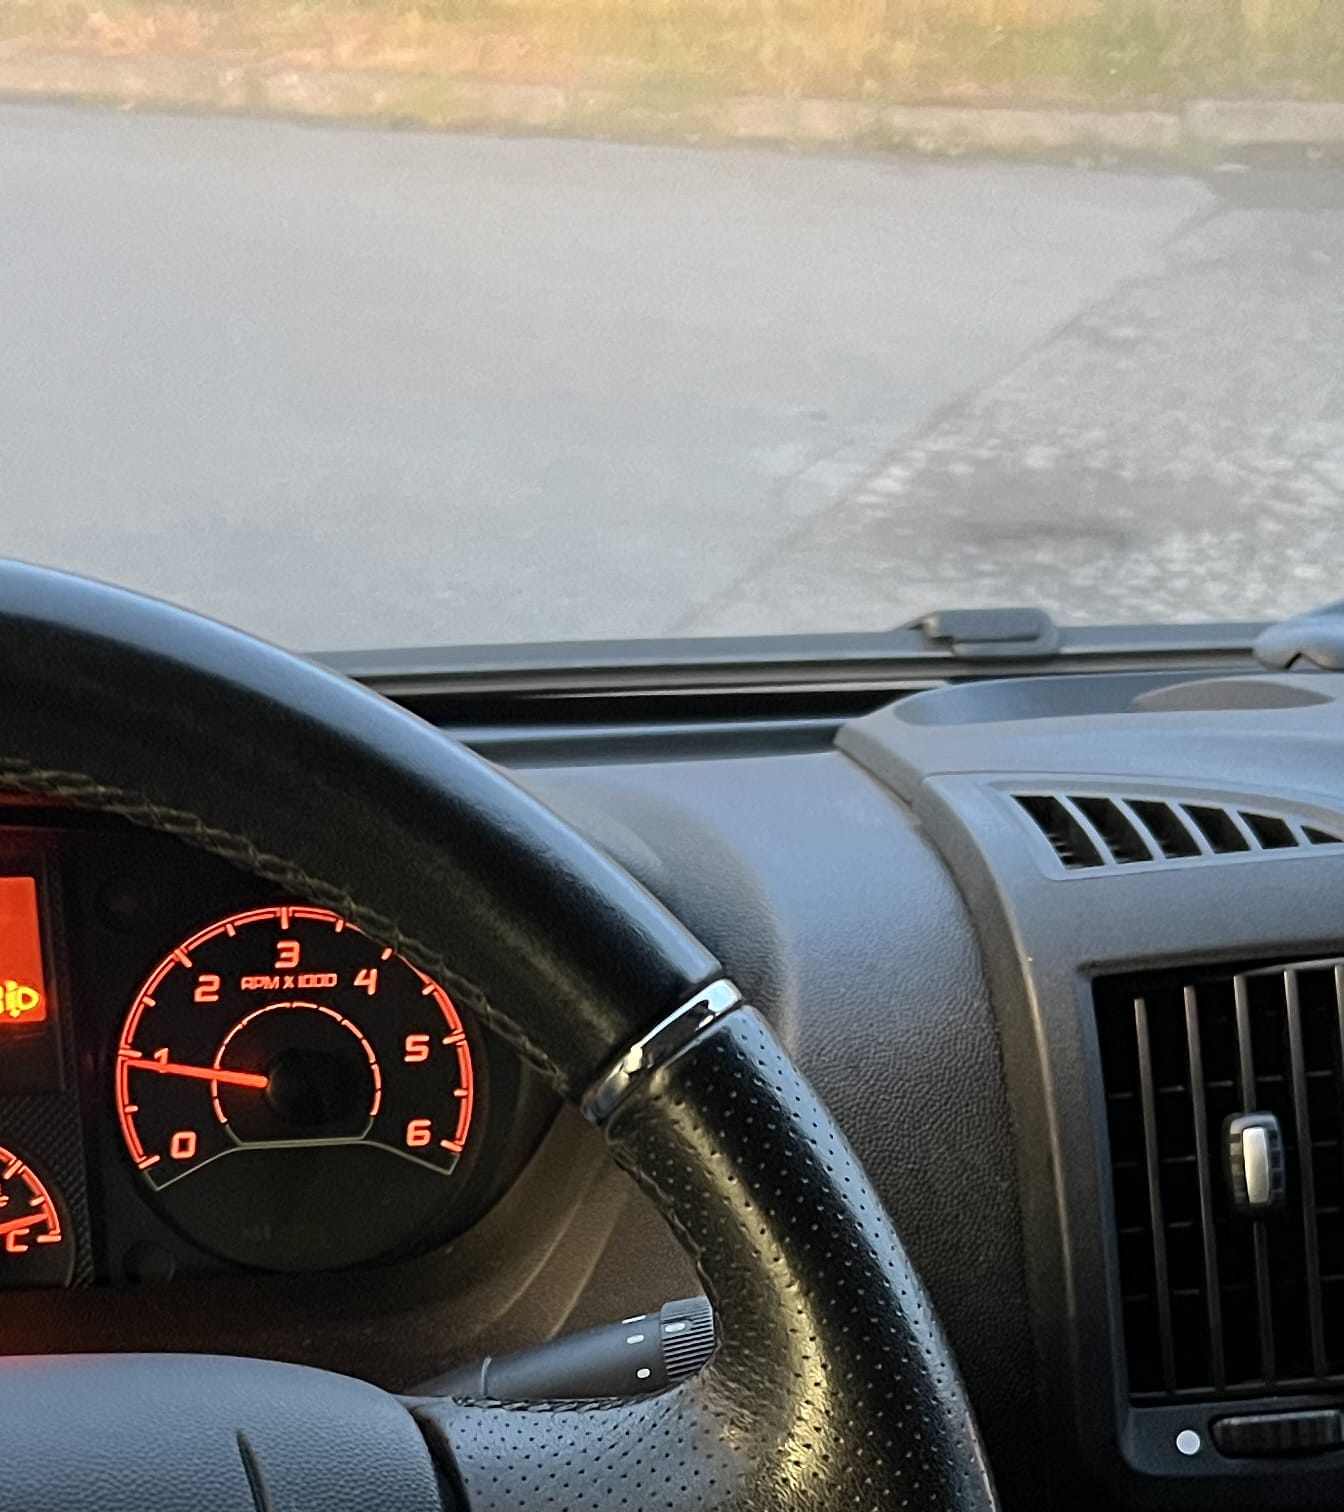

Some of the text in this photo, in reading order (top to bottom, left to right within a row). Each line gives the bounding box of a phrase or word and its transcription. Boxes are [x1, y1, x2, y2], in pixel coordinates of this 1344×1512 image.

[275, 941, 300, 968] 3
[194, 975, 220, 1002] 2
[241, 975, 280, 990] RPM
[297, 973, 338, 988] 1000
[354, 969, 378, 995] 4
[154, 1047, 169, 1073] 1
[404, 1034, 430, 1062] 5
[170, 1131, 197, 1158] 0
[406, 1120, 431, 1146] 6
[6, 1228, 30, 1252] C
